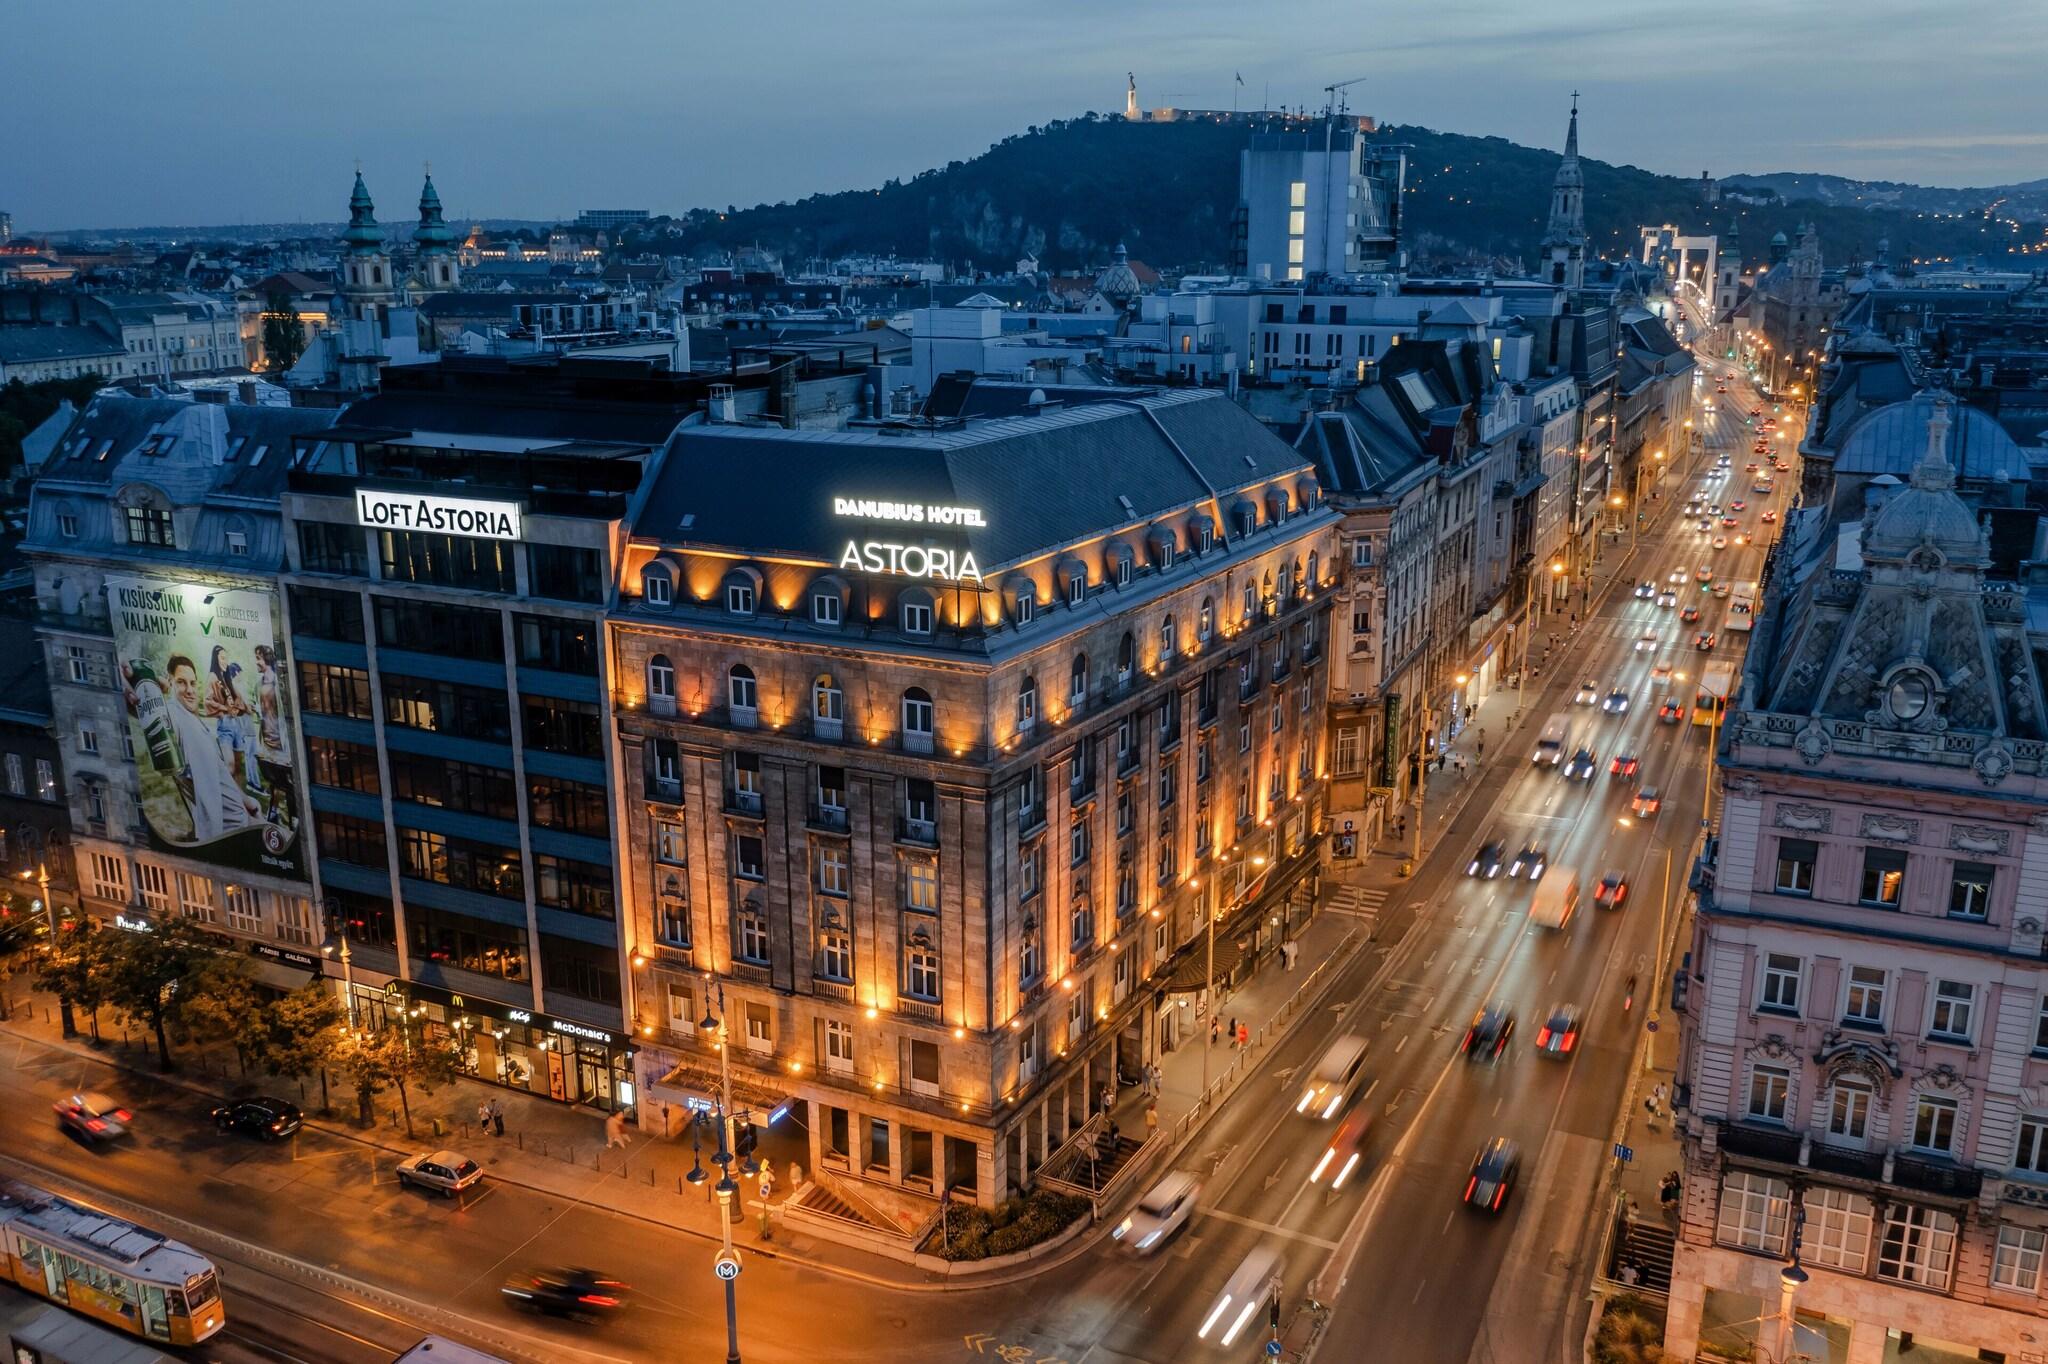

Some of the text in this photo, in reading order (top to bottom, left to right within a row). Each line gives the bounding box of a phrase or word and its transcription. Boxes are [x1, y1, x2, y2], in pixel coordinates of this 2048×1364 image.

[361, 495, 513, 536] LOFT ASTORIA
[834, 498, 987, 527] DANUBIUS HOTEL
[839, 540, 983, 583] ASTORIA
[119, 585, 185, 614] KISÜSSÜNK
[121, 611, 177, 636] VALAMIT?
[218, 624, 248, 640] INDULOK
[553, 1020, 612, 1043] McDonald's
